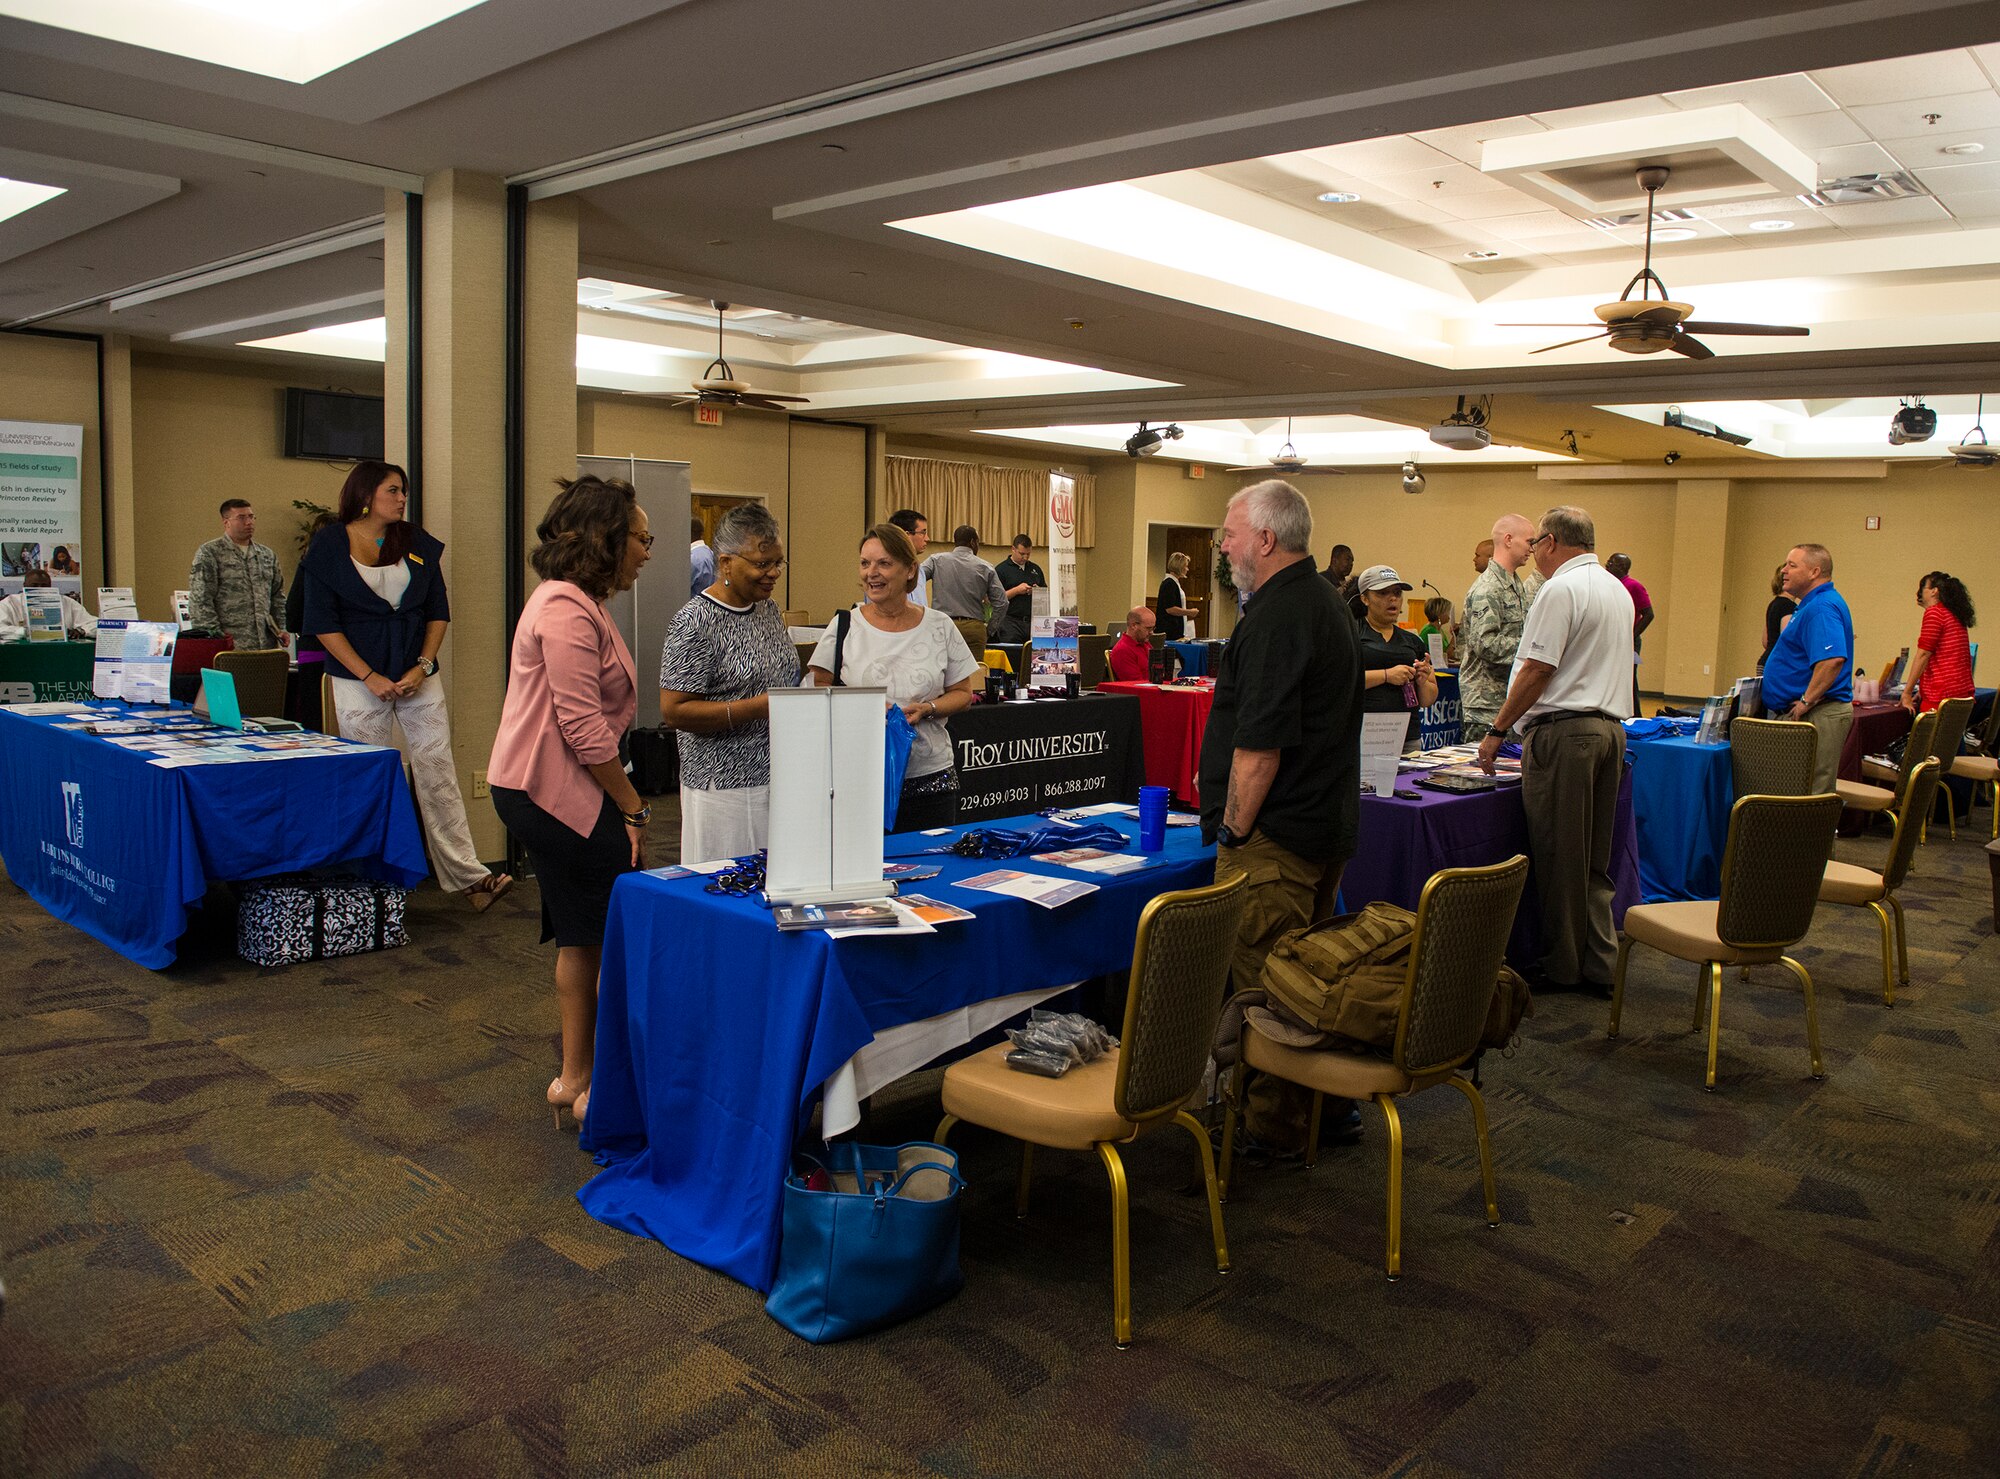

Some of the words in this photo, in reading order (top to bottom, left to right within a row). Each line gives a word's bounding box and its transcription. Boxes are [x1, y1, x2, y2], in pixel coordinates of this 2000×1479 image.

[700, 406, 719, 423] EXIT
[33, 440, 75, 448] BIRMINGHAM
[41, 465, 62, 473] study
[24, 486, 56, 495] diversity
[39, 527, 63, 535] Report
[38, 681, 67, 692] THE
[958, 739, 1005, 769] TROY
[1009, 731, 1106, 761] UNIVERSITY
[1044, 776, 1106, 797] 866.288.2097
